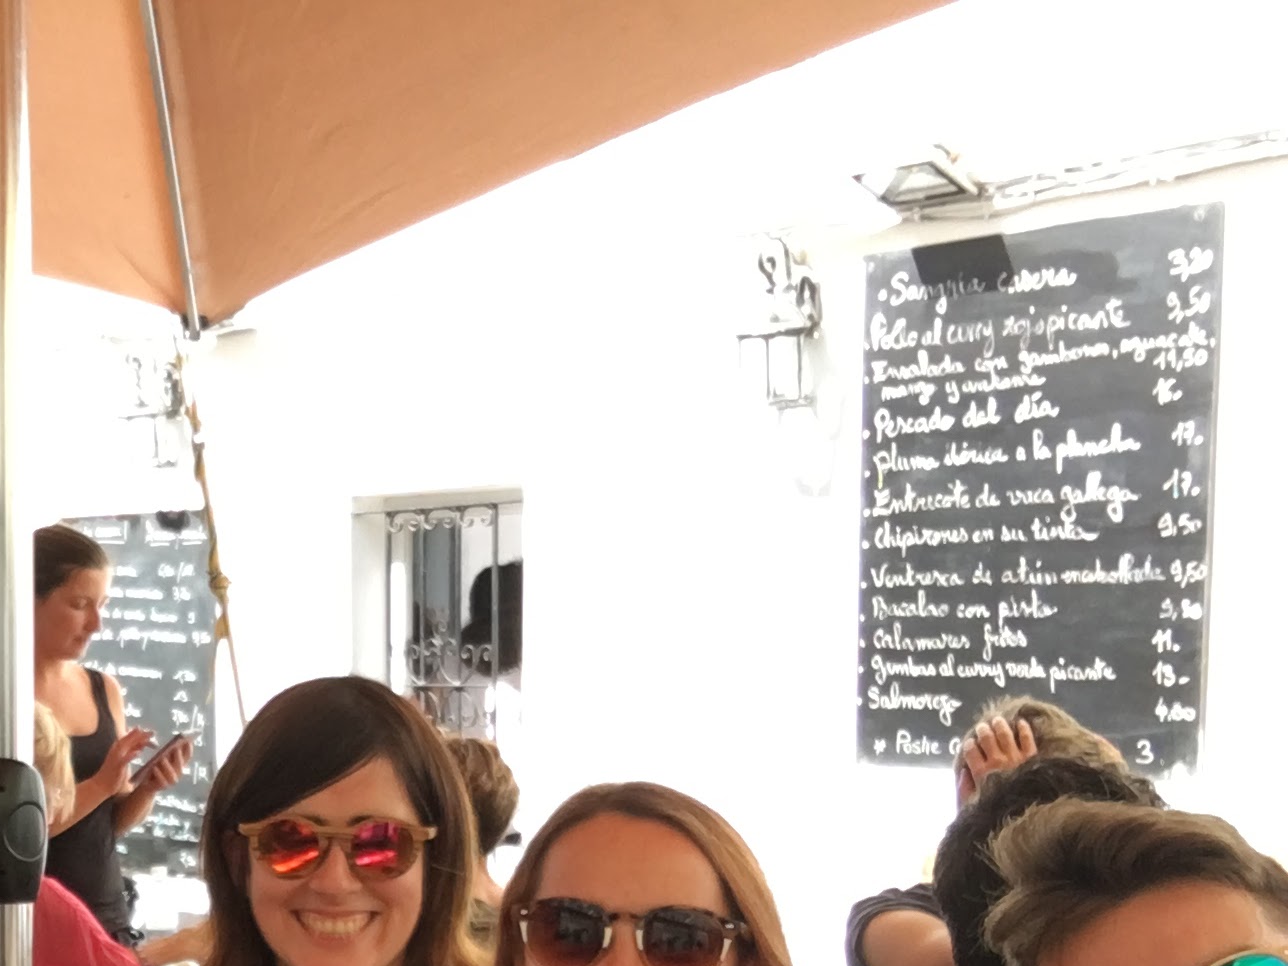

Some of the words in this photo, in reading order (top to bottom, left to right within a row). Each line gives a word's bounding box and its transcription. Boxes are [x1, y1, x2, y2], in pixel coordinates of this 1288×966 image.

[870, 311, 918, 352] Pollo
[920, 317, 944, 346] al
[946, 319, 996, 359] curry
[1046, 298, 1132, 351] picante
[870, 349, 966, 384] Ensalada
[944, 380, 961, 404] y
[873, 405, 956, 443] Pescado
[962, 396, 1002, 428] del
[1015, 445, 1027, 461] a
[1032, 428, 1053, 460] la
[975, 483, 1001, 508] de
[1060, 470, 1142, 523] gallega
[874, 520, 970, 559] Chipirones
[972, 528, 995, 544] en
[1000, 525, 1029, 543] su
[871, 589, 951, 621] Bacalao
[956, 603, 991, 619] con
[872, 620, 971, 652] Calamares
[938, 653, 955, 677] al
[956, 662, 1006, 689] curry
[1049, 656, 1117, 694] picante
[867, 681, 963, 727] Salmorejo
